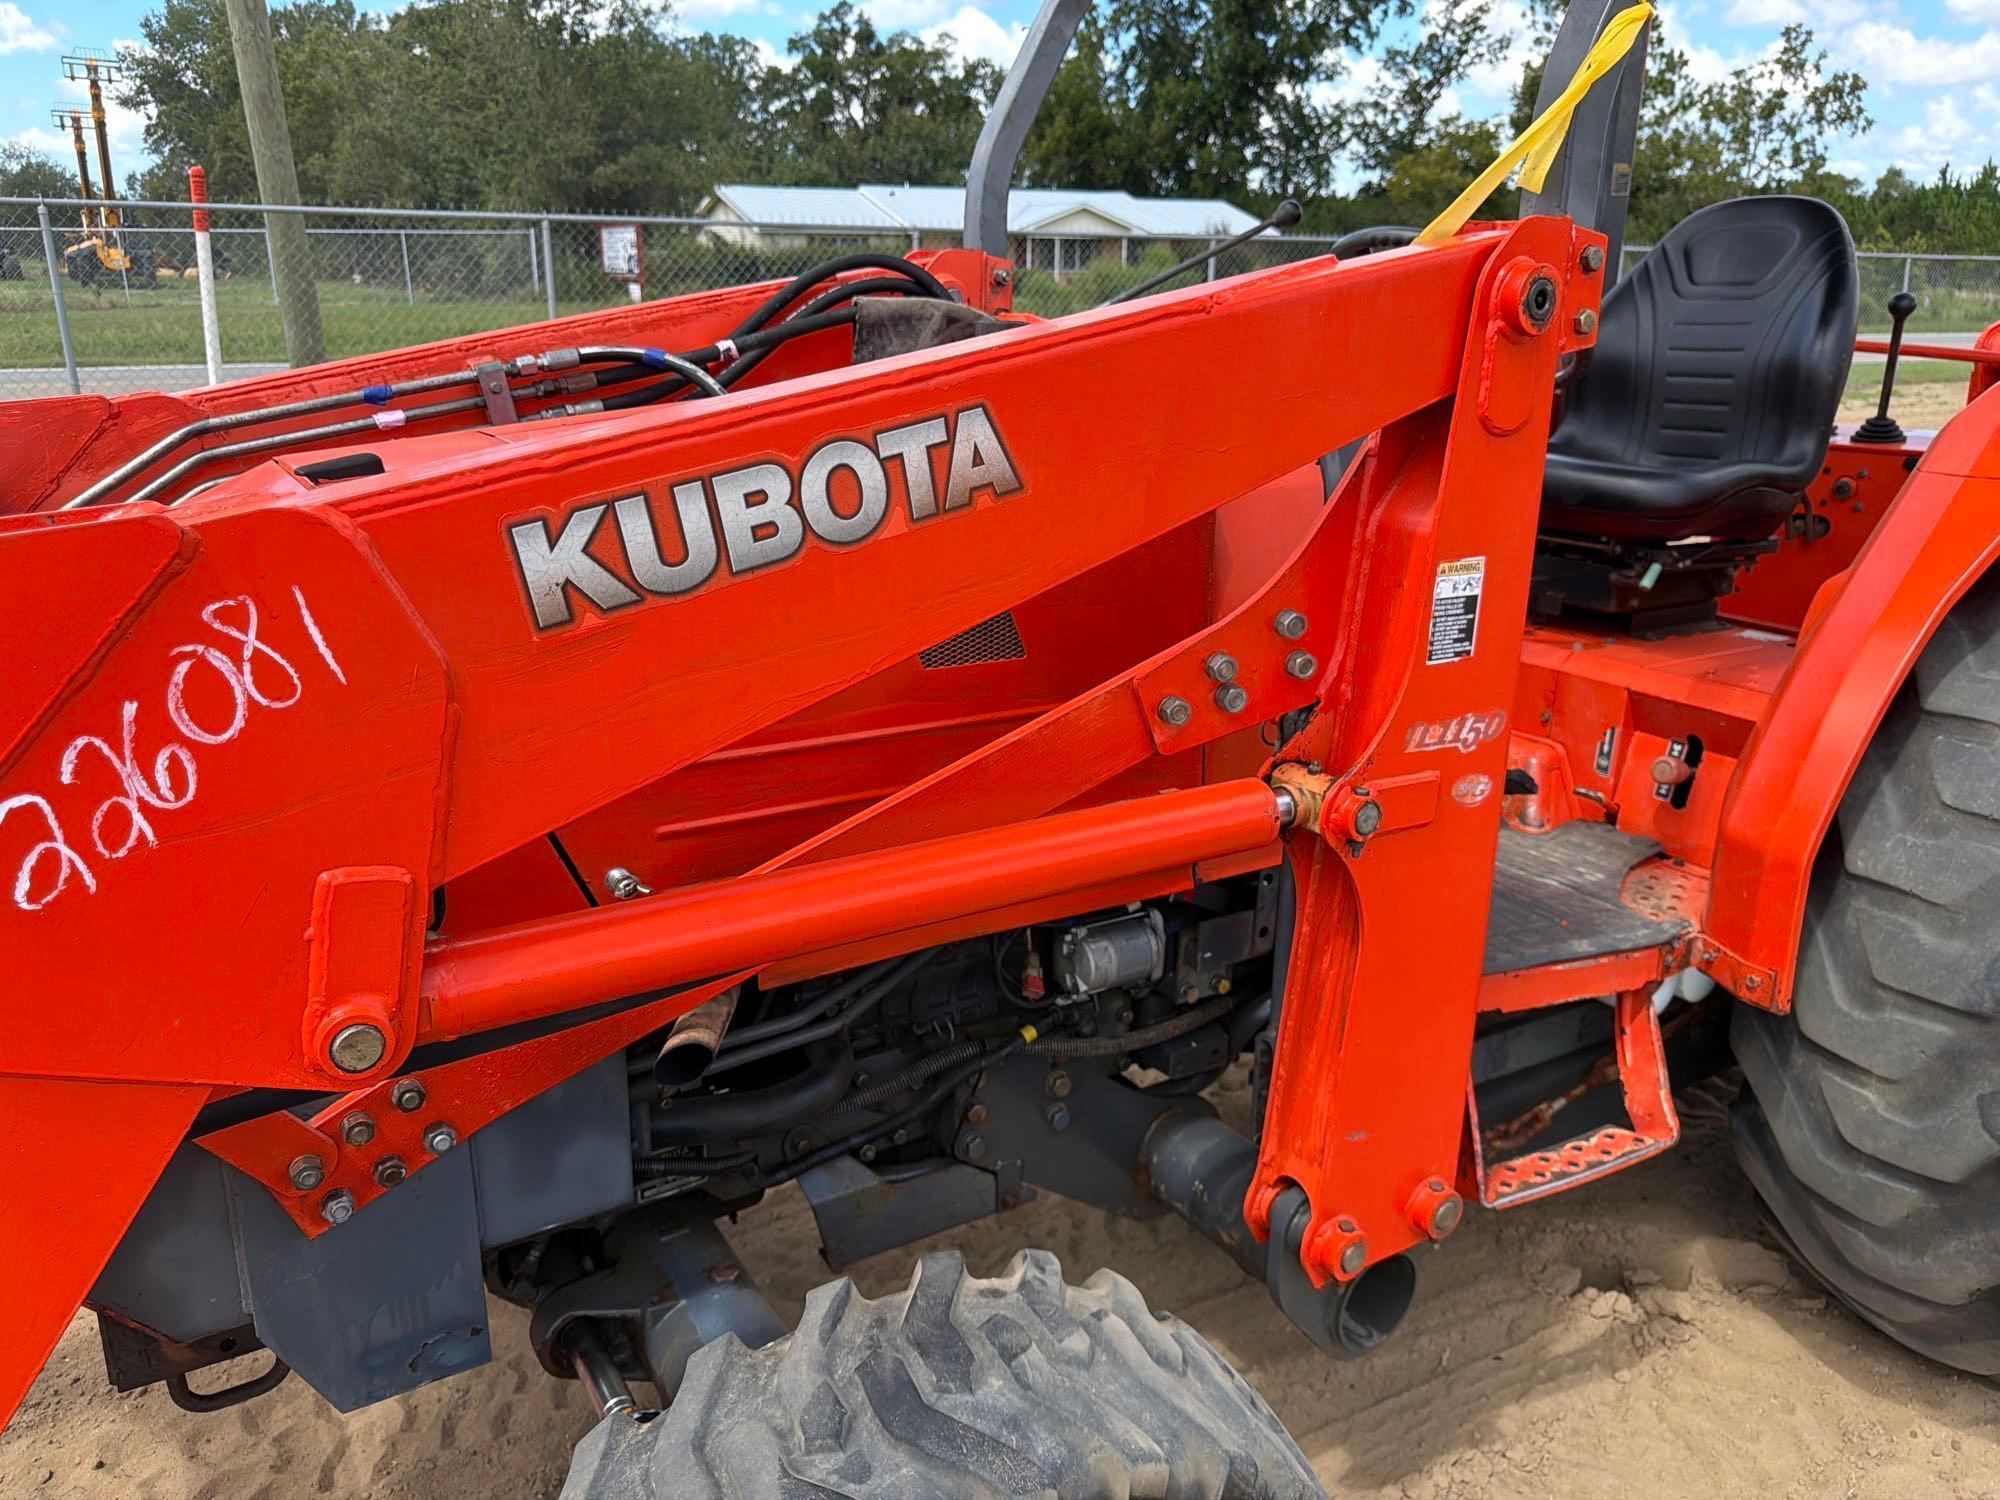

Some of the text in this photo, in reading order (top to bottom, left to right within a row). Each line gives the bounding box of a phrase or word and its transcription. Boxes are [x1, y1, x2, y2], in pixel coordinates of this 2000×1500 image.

[509, 404, 1025, 631] KUBOTA
[1447, 562, 1480, 574] WARNING
[0, 585, 347, 909] 226081
